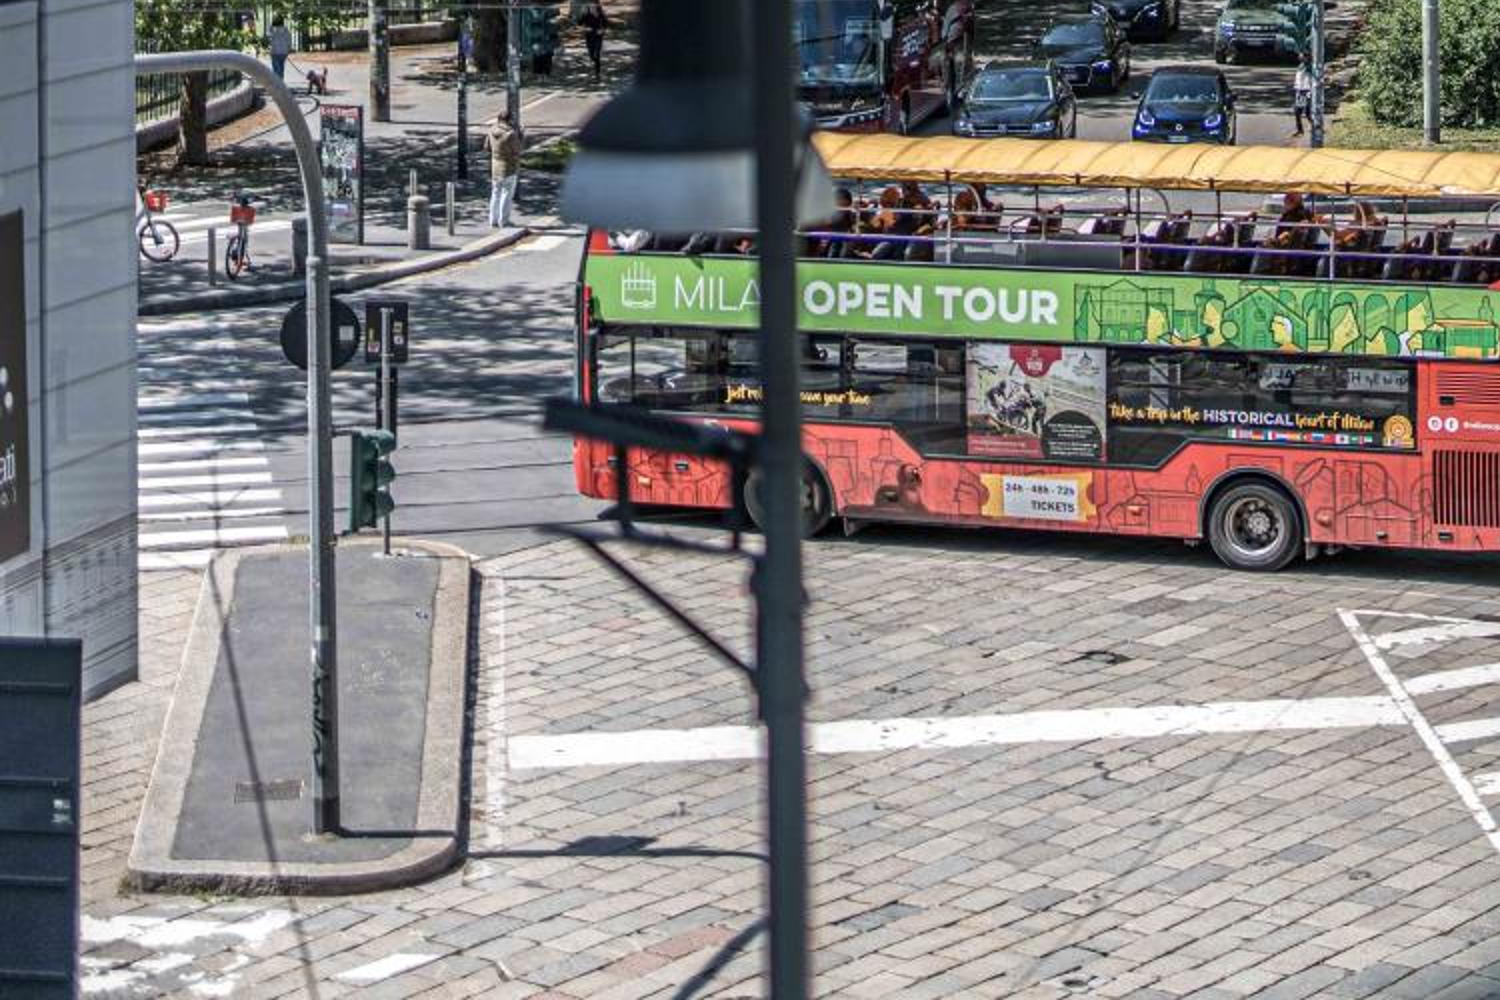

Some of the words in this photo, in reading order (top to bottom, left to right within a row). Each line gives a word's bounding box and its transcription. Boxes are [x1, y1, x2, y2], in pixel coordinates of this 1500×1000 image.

[675, 274, 762, 311] MILA
[803, 280, 923, 319] OPEN
[935, 285, 1059, 325] TOUR
[1203, 409, 1295, 427] HISTORICAL
[1327, 411, 1341, 431] of
[1005, 482, 1023, 493] 24h
[1030, 499, 1076, 513] TICKETS
